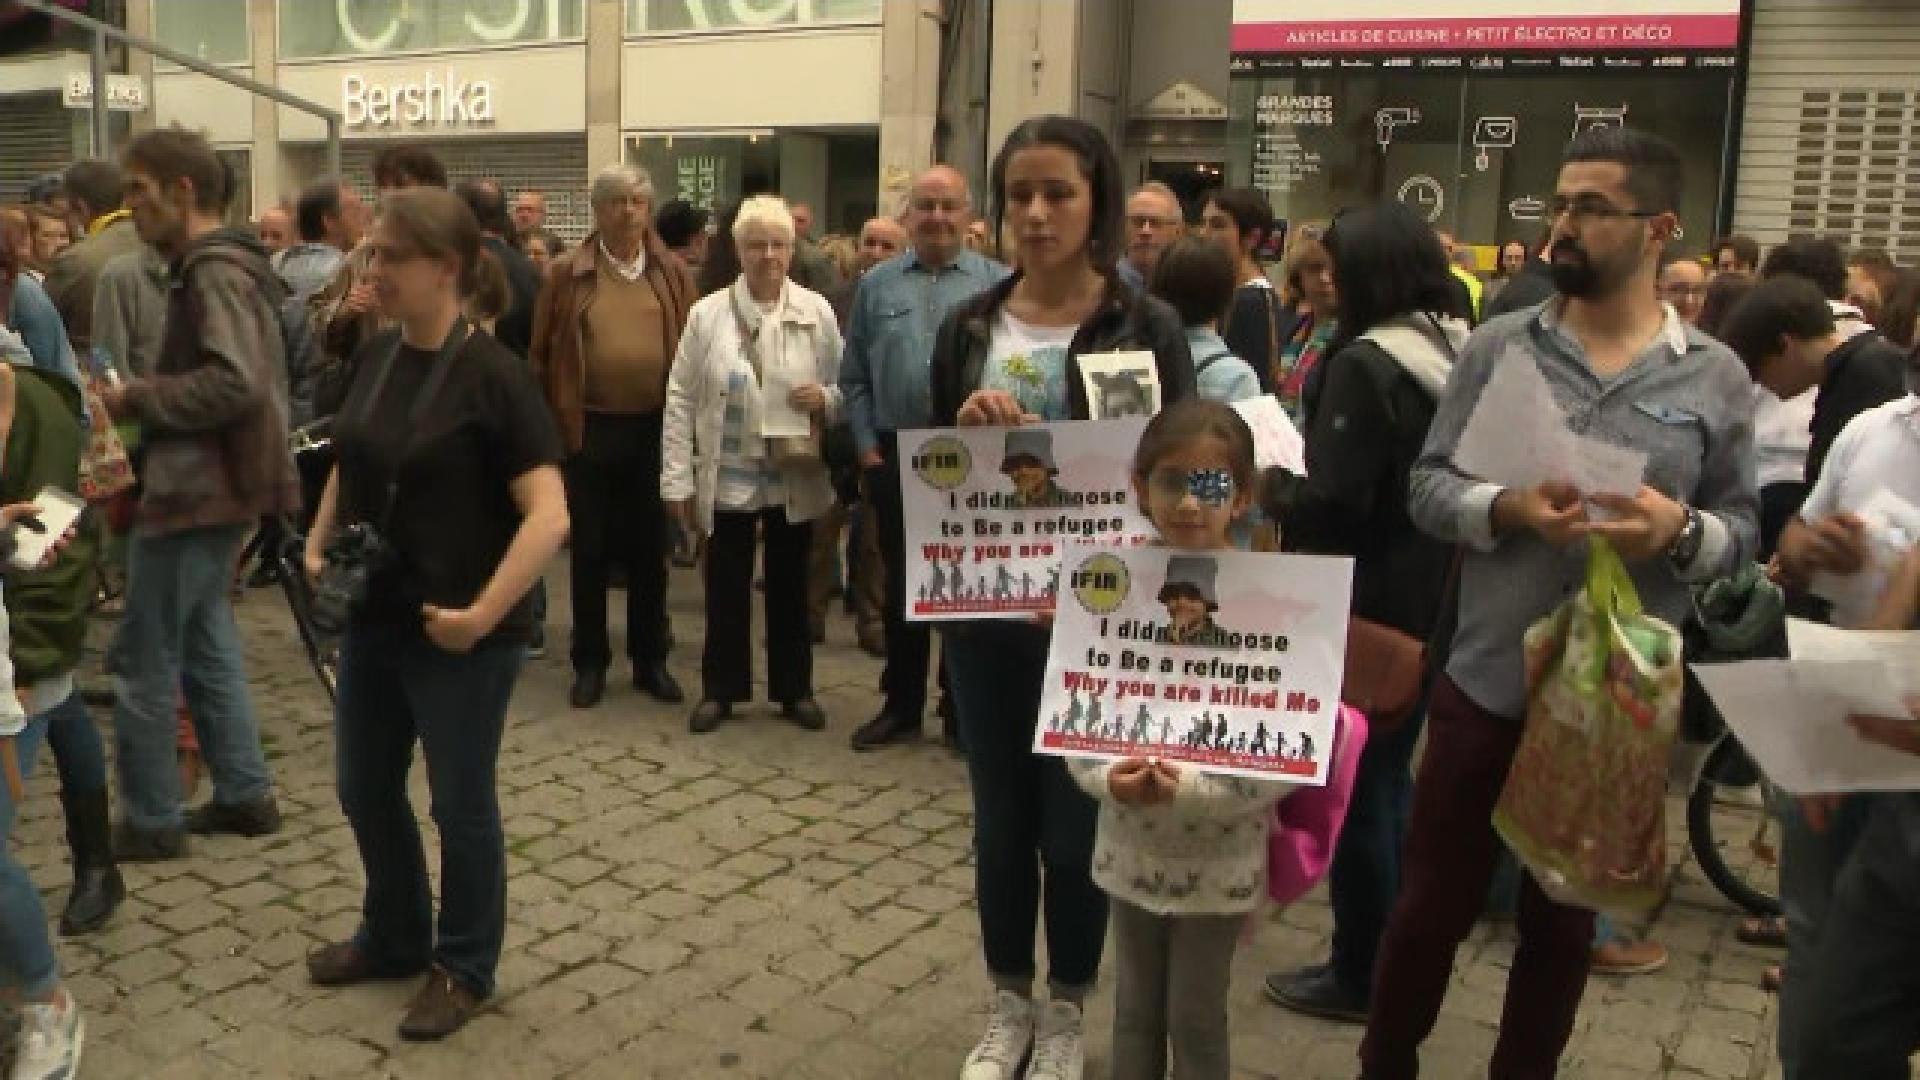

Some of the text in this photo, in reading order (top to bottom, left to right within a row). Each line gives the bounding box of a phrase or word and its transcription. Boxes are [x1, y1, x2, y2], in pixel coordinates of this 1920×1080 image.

[1287, 30, 1356, 43] ARTICLES
[1362, 29, 1384, 43] DE
[1389, 28, 1449, 43] CUISINE
[1467, 27, 1509, 40] PETIT
[1515, 25, 1591, 40] ÉLECTRO
[1596, 26, 1617, 40] ET
[1623, 24, 1672, 40] DÉCO
[344, 69, 491, 124] Bershka
[1257, 96, 1332, 109] GRANDES
[1257, 111, 1332, 124] MARQUES
[950, 492, 957, 509] I
[941, 515, 1122, 538] to Be a refugee
[923, 543, 1054, 564] Why you are
[1100, 617, 1108, 637] I
[1086, 647, 1281, 684] to Be a refugee
[1064, 671, 1320, 714] Why you are killed Me
